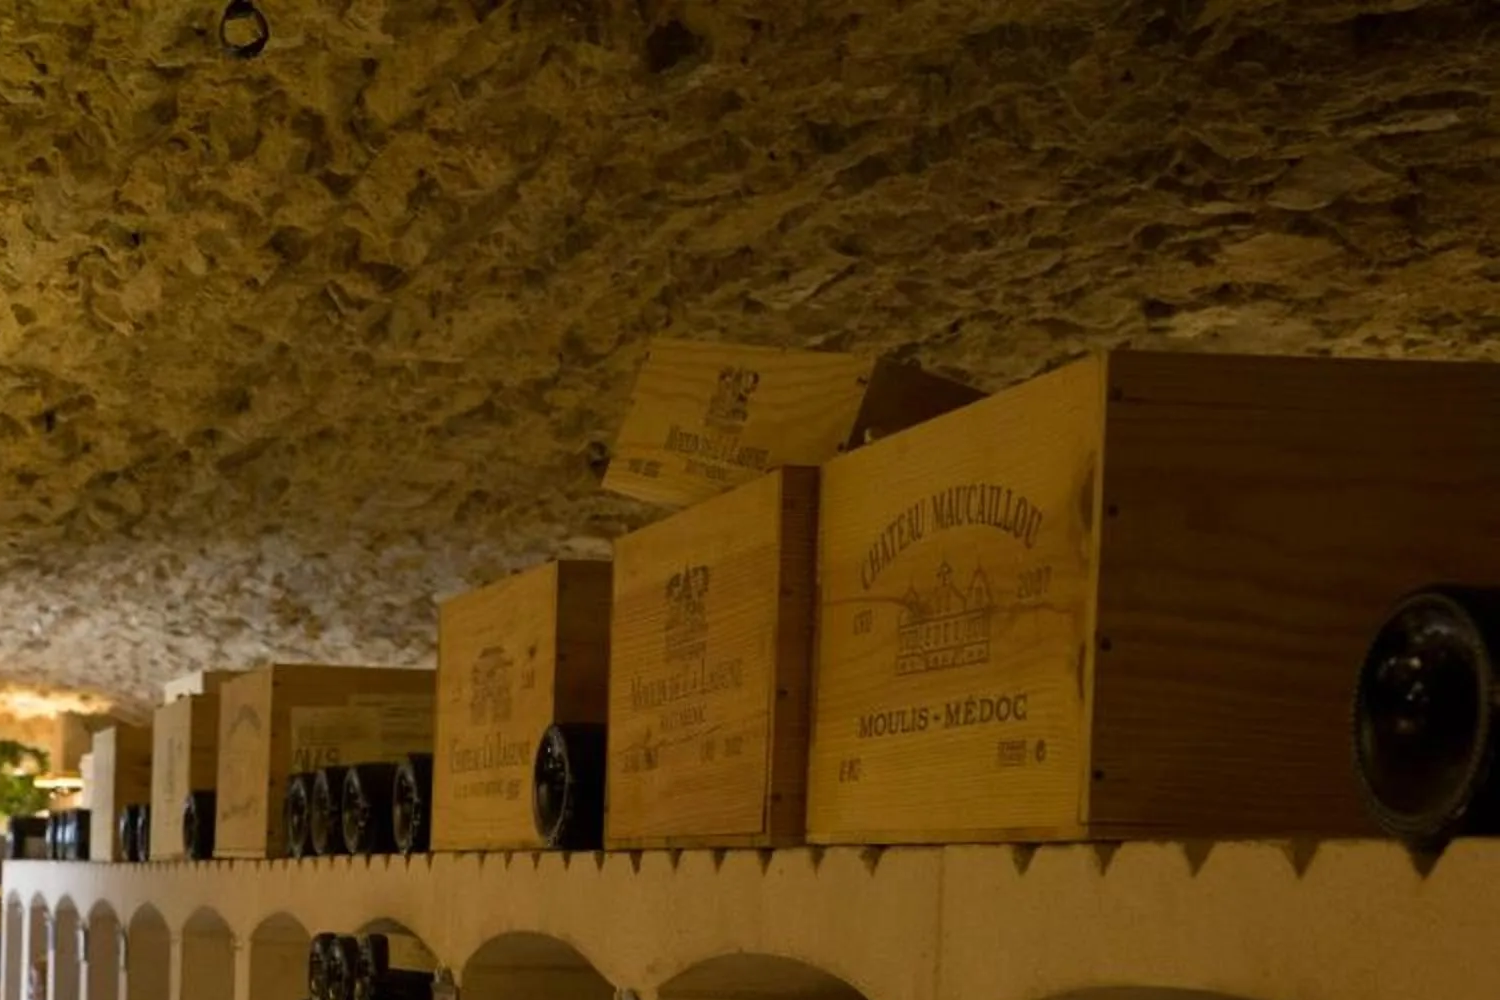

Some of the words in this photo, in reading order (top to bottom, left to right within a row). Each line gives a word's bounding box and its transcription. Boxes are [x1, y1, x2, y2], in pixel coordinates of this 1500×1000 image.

[931, 483, 1044, 549] MAUCAILLOU
[857, 707, 930, 739] MOULIS
[943, 692, 1028, 729] MÉDOC
